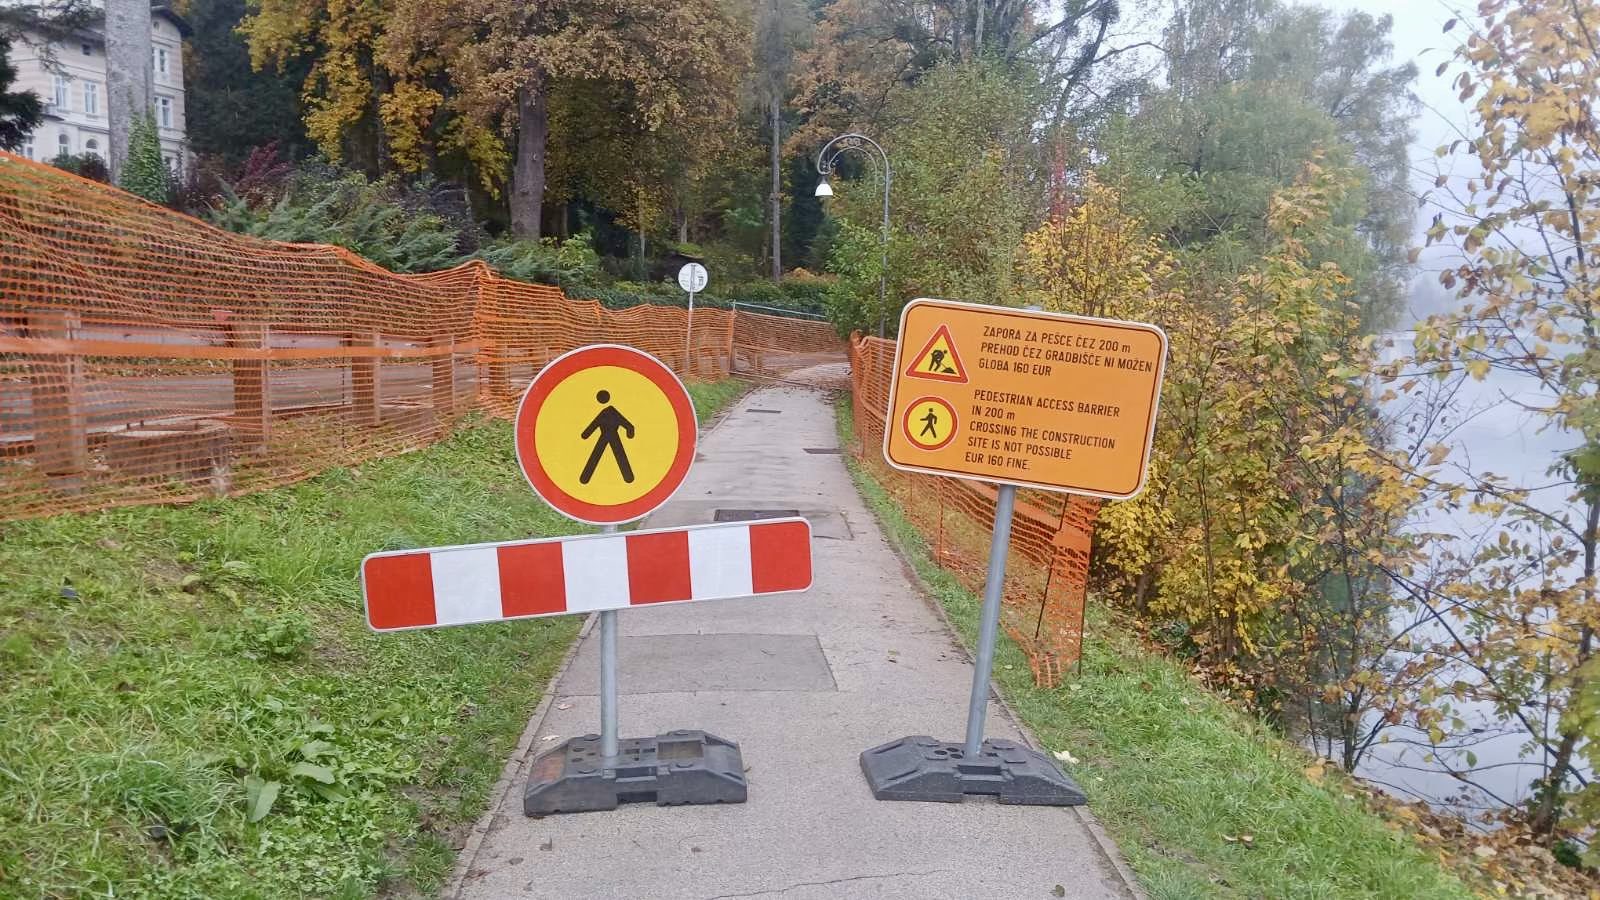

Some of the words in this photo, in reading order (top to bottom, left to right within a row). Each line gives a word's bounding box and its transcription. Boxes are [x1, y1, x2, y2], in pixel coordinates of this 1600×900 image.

[983, 326, 1021, 340] ZAPORA
[1024, 331, 1037, 343] ZA
[1041, 332, 1073, 347] PEŠCE
[1075, 334, 1096, 350] ČEZ
[1098, 339, 1119, 352] 200
[1121, 344, 1131, 353] m
[978, 358, 1009, 372] GLOBA
[1013, 361, 1029, 374] 160
[1032, 364, 1052, 376] EUR
[981, 342, 1020, 357] PREHOD
[1022, 345, 1042, 360] ČEZ
[1045, 349, 1102, 366] GRADBIŠČE
[1104, 356, 1115, 368] NI
[1117, 357, 1152, 372] MOŽEN
[971, 405, 982, 416] IN
[984, 407, 1004, 419] 200
[1006, 412, 1015, 421] m
[974, 389, 1033, 406] PEDESTRIAN
[1036, 397, 1074, 412] ACCESS
[1077, 402, 1120, 417] BARRIER
[969, 420, 1017, 437] CROSSING
[1021, 427, 1039, 440] THE
[1041, 430, 1115, 449] CONSTRUCTION
[965, 451, 984, 464] EUR
[988, 454, 1003, 466] 160
[1006, 457, 1030, 470] FINE.
[967, 436, 990, 449] SITE
[991, 439, 1001, 450] IS
[1003, 441, 1024, 453] NOT
[1026, 443, 1072, 460] POSSIBLE
